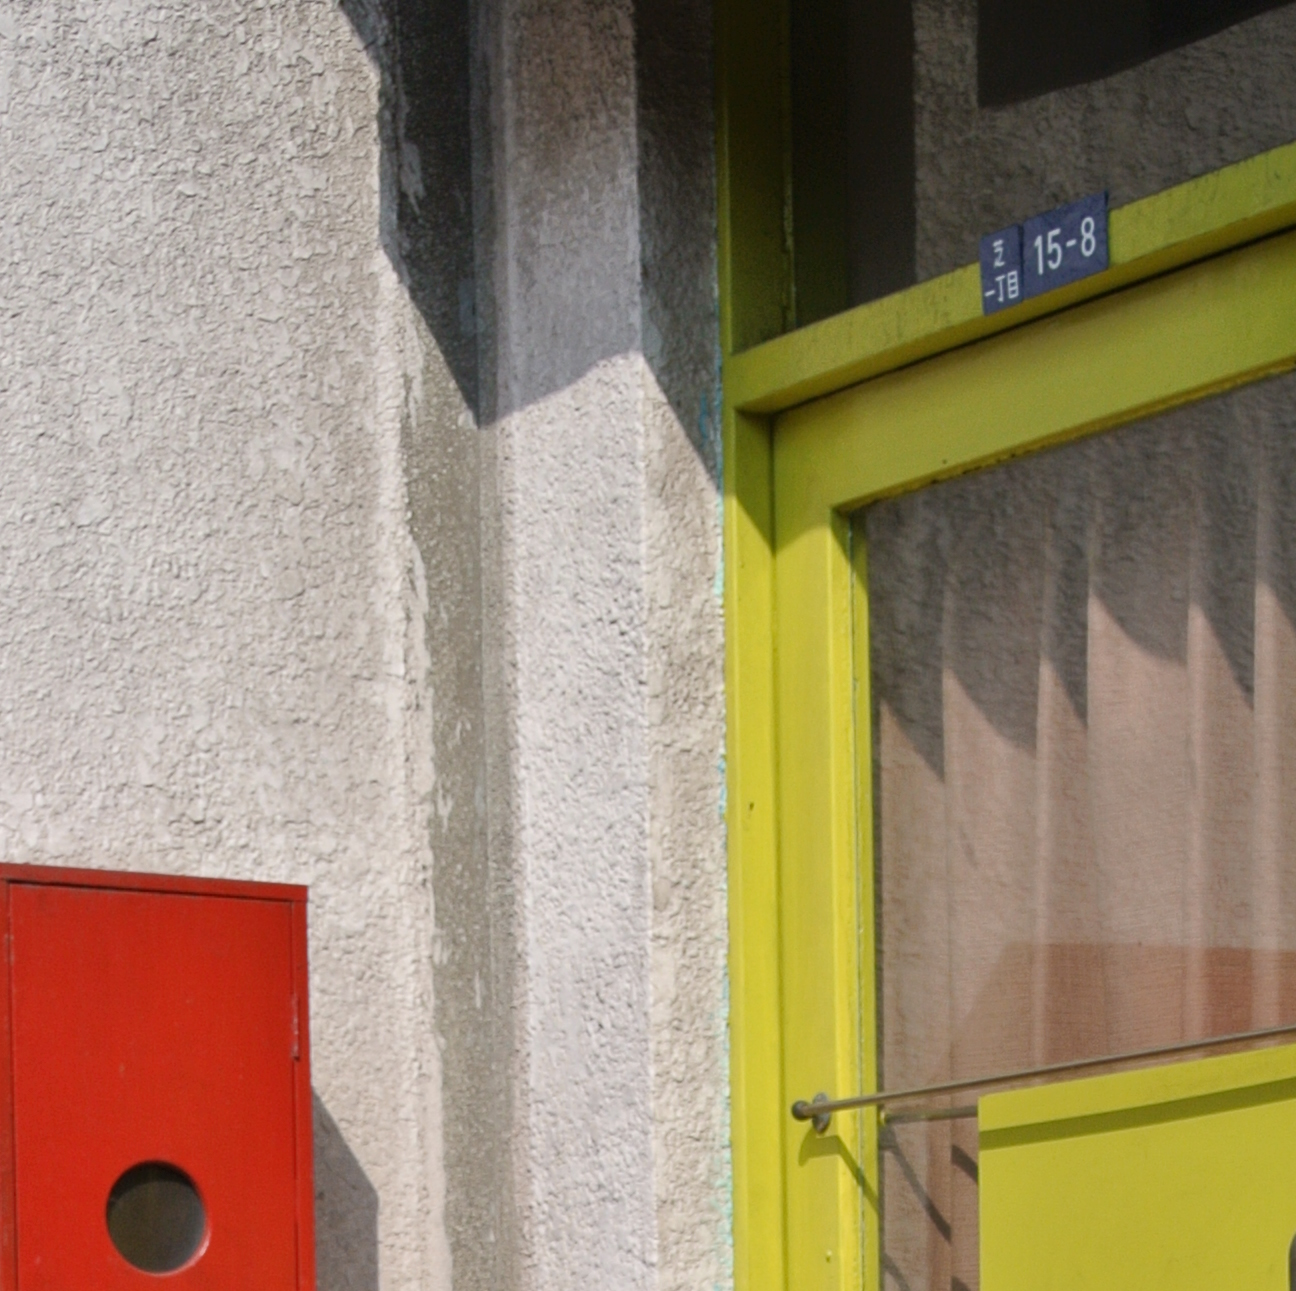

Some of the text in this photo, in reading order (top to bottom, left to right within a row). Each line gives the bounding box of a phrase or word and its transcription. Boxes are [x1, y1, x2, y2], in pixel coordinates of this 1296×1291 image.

[1034, 216, 1096, 275] 15-8
[984, 270, 1019, 303] 一丁目
